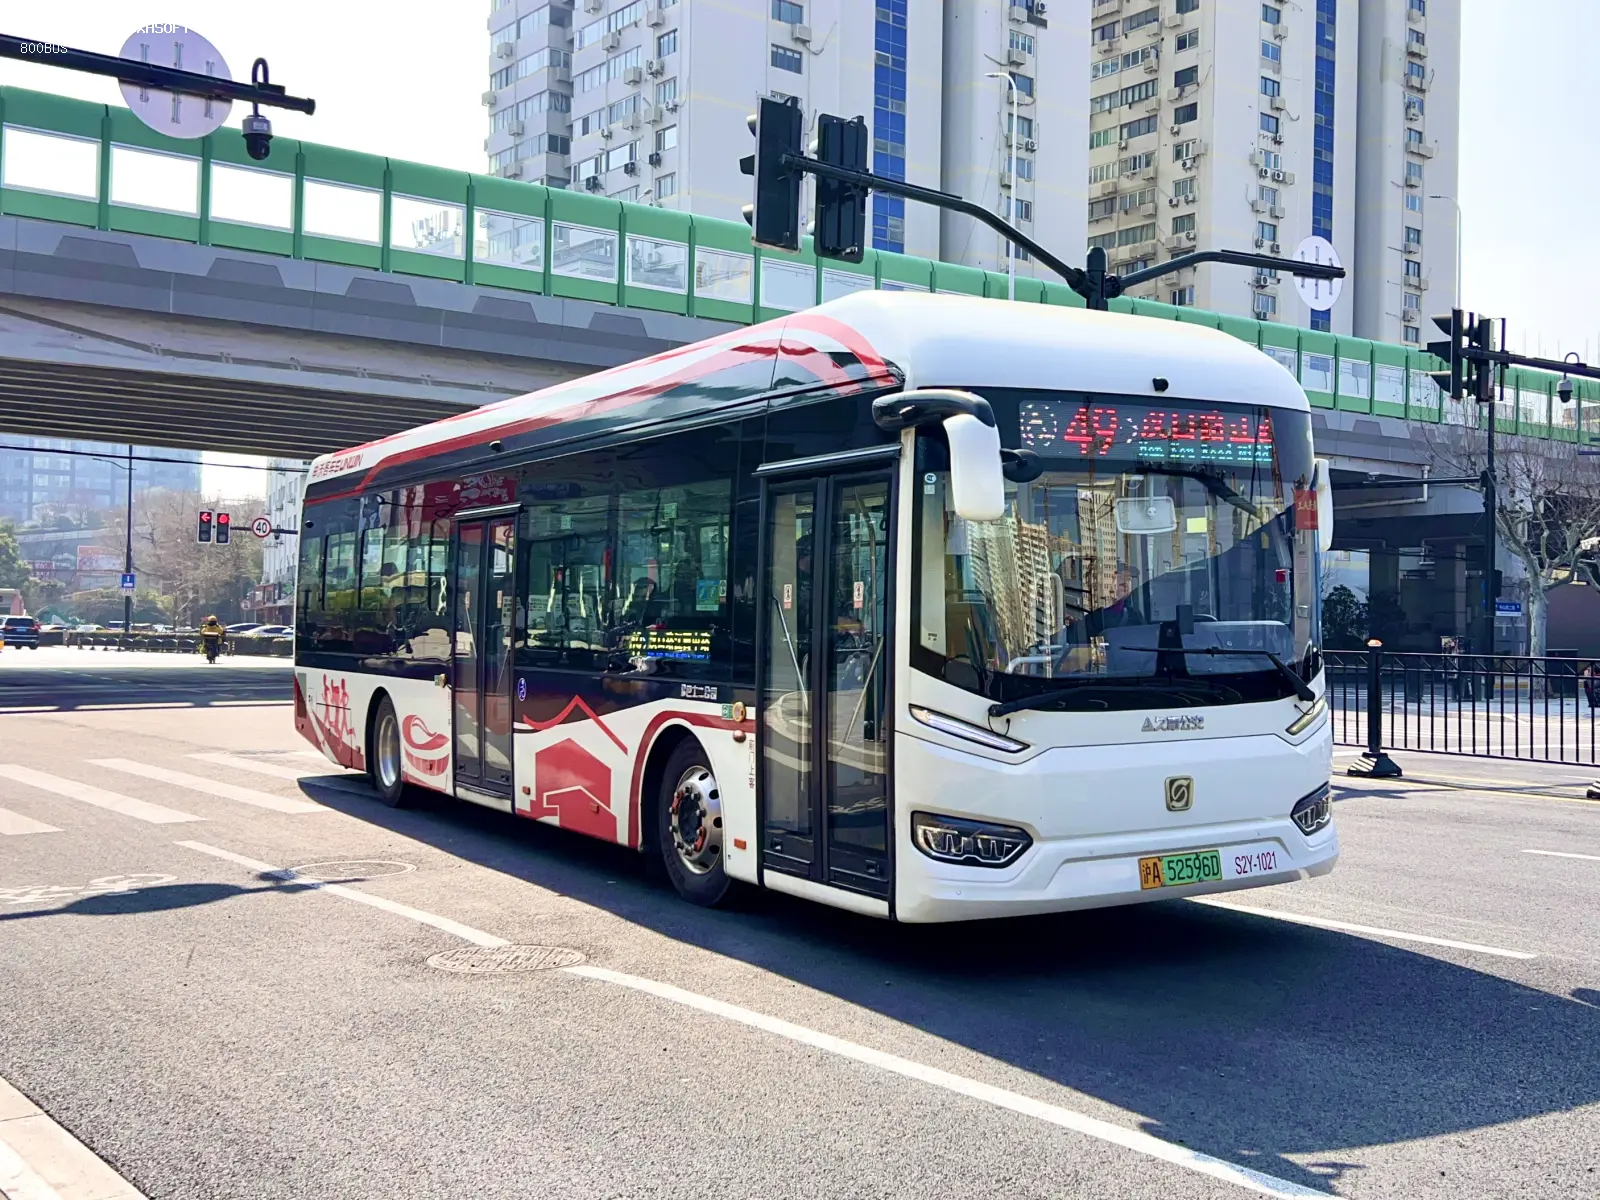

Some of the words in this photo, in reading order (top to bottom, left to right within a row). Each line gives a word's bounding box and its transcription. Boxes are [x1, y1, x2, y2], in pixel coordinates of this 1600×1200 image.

[1064, 407, 1118, 455] 49
[256, 522, 268, 533] 40
[1235, 851, 1278, 875] S2Y-1021
